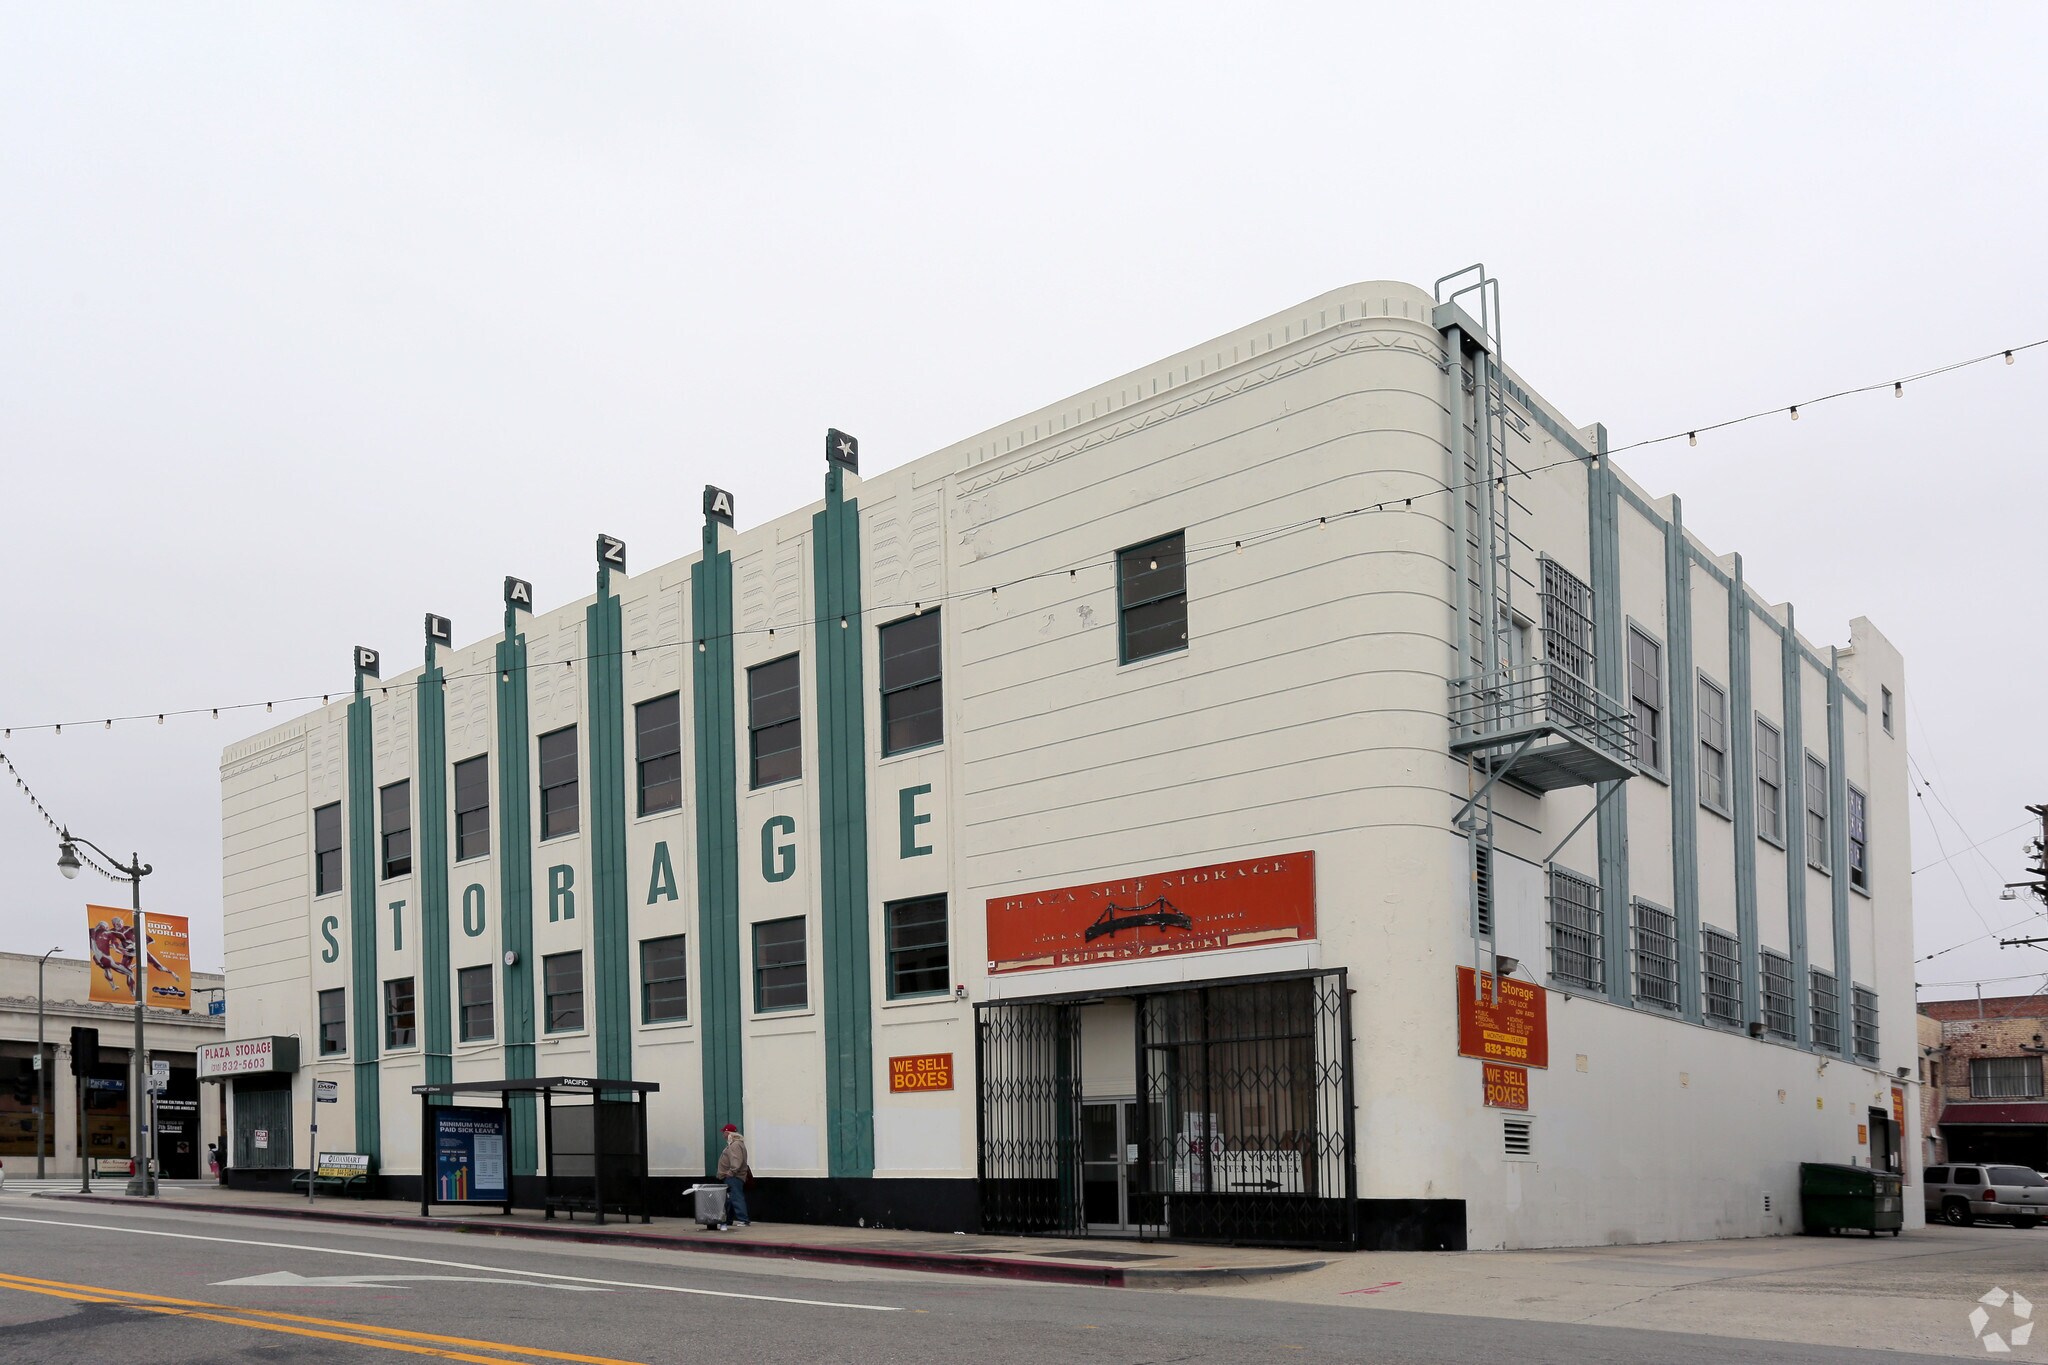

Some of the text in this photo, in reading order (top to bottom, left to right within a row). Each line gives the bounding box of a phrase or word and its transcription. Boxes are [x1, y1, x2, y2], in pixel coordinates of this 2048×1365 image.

[147, 922, 174, 931] BODY
[148, 928, 188, 938] WORLDS
[1501, 981, 1534, 1001] Storage
[1517, 1000, 1528, 1009] LOCK
[1486, 1032, 1505, 1041] MONTHLY
[205, 1041, 271, 1060] PLAZA STORAGE
[1484, 1042, 1527, 1059] 832-5603
[222, 1057, 265, 1072] 832-5603
[893, 1058, 949, 1073] WE SELL
[564, 1078, 588, 1086] PACIFIC
[894, 1071, 948, 1088] BOXES
[1486, 1067, 1525, 1086] WE SELL
[90, 1079, 110, 1087] Pacific
[1487, 1084, 1525, 1105] BOXES
[1212, 1153, 1301, 1162] PLAZA STORAGE
[1212, 1165, 1301, 1174] ENTER IN ALLEY
